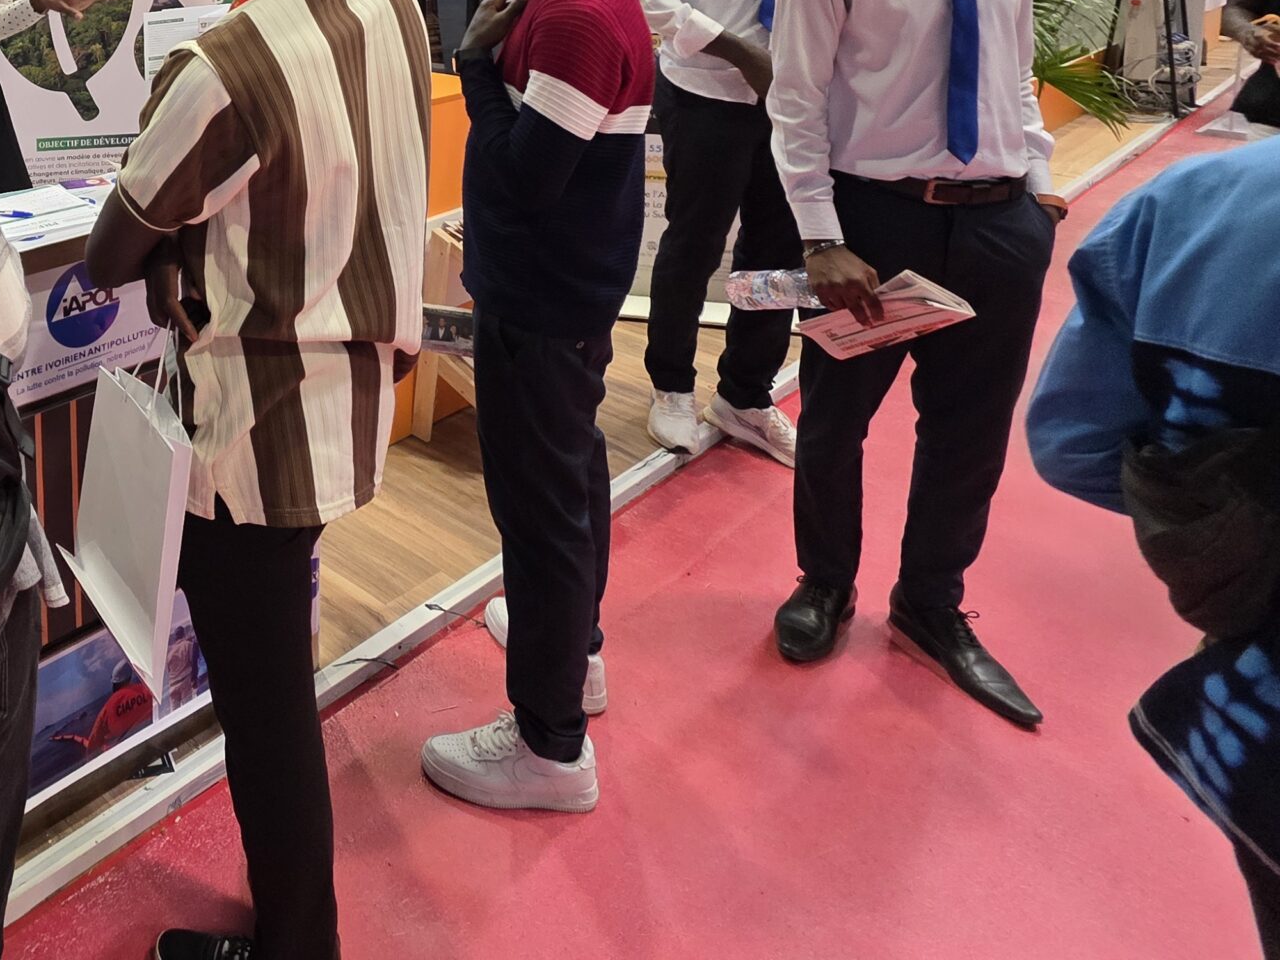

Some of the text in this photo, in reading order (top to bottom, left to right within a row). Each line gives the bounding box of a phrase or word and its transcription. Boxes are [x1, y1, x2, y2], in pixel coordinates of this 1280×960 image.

[38, 135, 138, 149] OBJECTIF DE DÉVELOP
[67, 153, 91, 161] modèle
[70, 166, 106, 176] climatique,
[11, 326, 161, 384] ENTRE IVOIRIEN ANTIPOLLUTION
[26, 381, 43, 392] lutte
[44, 375, 66, 386] contre
[67, 370, 74, 378] la
[106, 353, 123, 362] notre
[124, 343, 146, 358] priorité
[116, 693, 148, 717] CIAPOL
